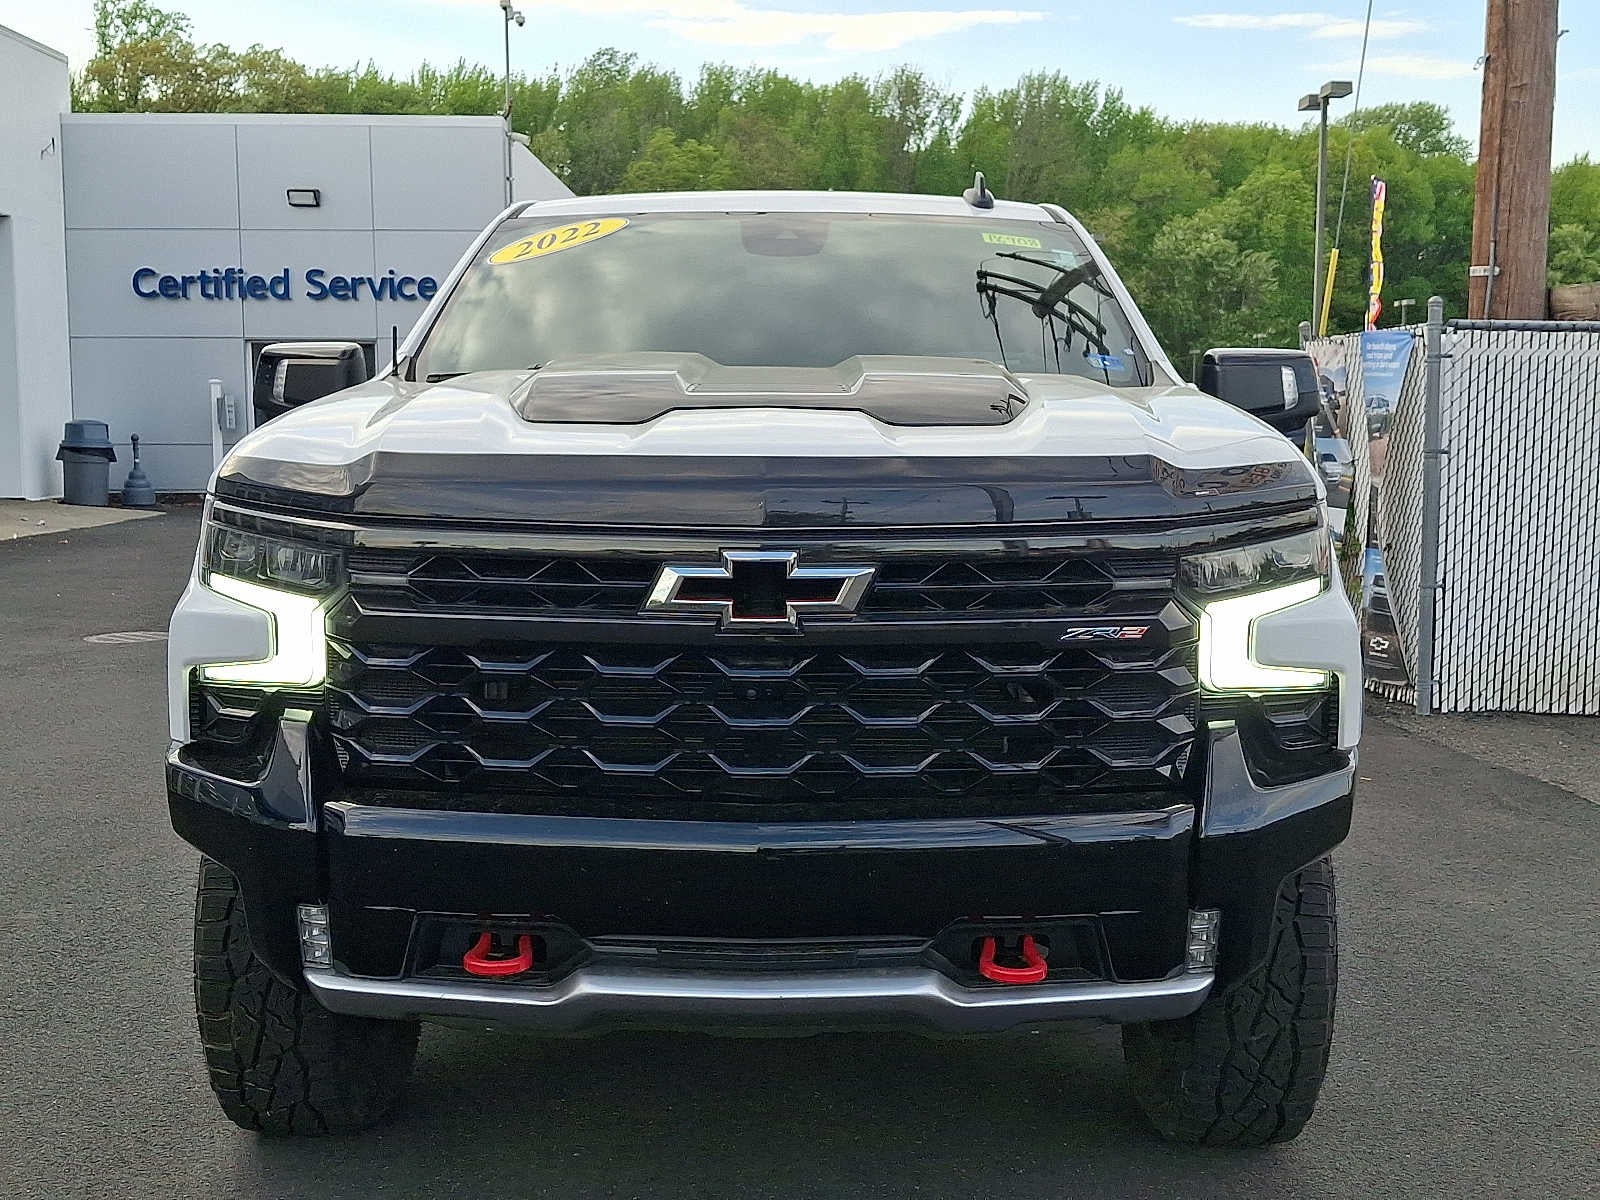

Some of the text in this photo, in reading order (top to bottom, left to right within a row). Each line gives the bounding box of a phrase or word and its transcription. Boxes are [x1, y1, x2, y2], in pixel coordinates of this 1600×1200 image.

[513, 222, 601, 259] 2022
[132, 267, 437, 300] Certified Service
[1060, 625, 1150, 640] ZR2
